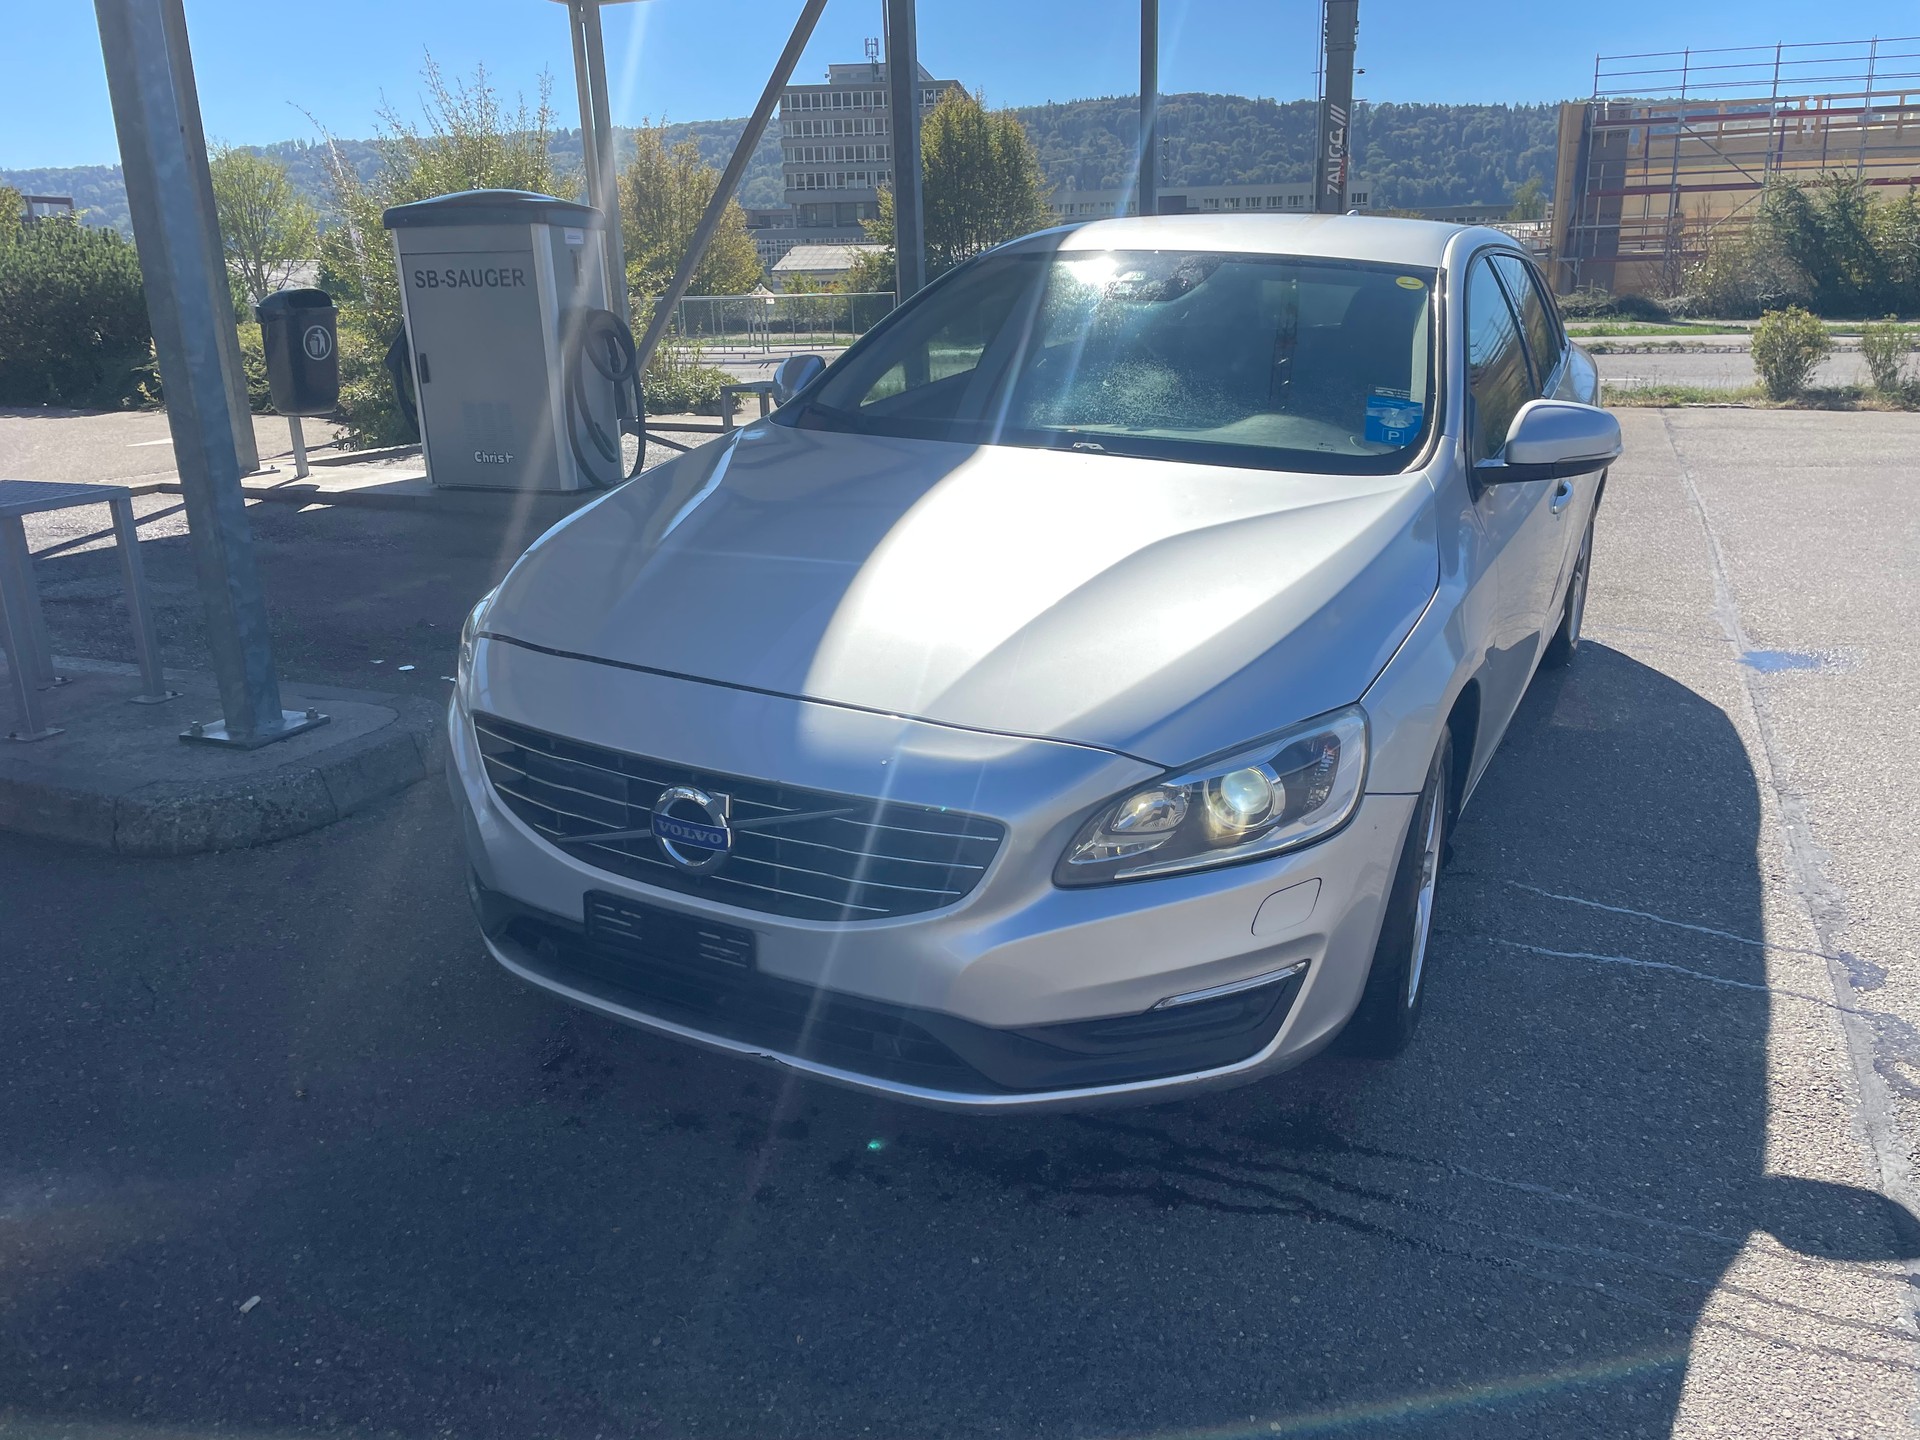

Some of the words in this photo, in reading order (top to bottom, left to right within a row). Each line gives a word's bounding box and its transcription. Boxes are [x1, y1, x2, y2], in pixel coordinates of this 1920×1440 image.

[414, 267, 526, 289] SB-SAUGER
[1387, 430, 1400, 441] P
[473, 450, 515, 464] Christ
[657, 819, 723, 845] VOLVO
